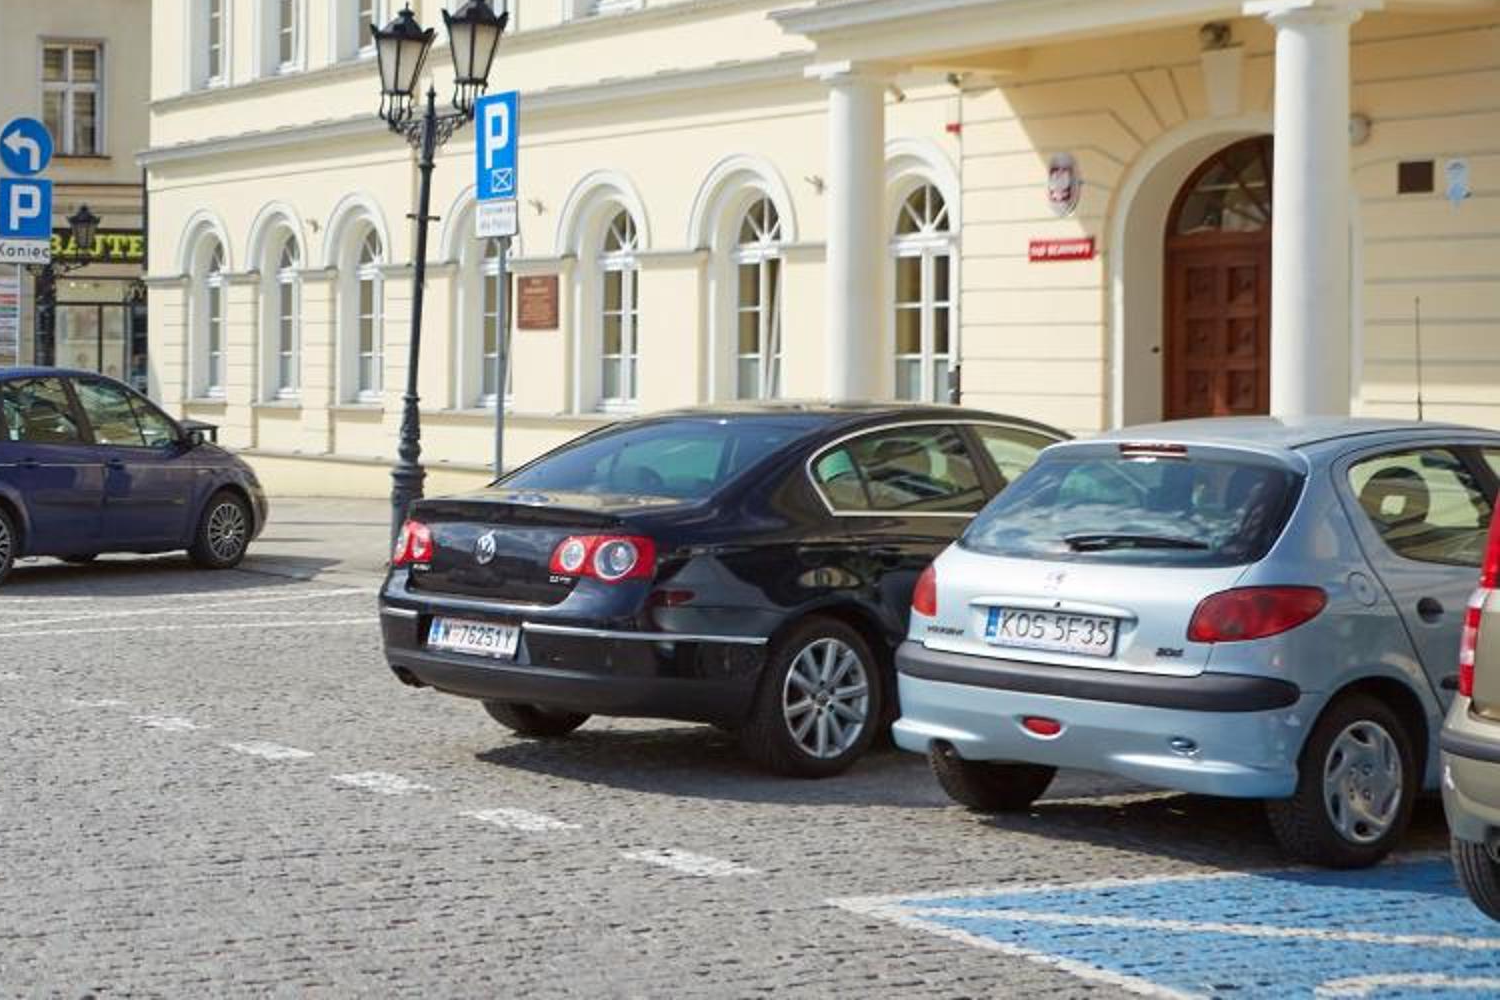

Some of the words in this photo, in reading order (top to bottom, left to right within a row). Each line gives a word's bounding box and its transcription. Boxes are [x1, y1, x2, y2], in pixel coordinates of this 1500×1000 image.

[485, 102, 509, 169] P
[9, 184, 41, 230] P
[1000, 610, 1046, 640] KOS
[1052, 614, 1110, 646] 5F35
